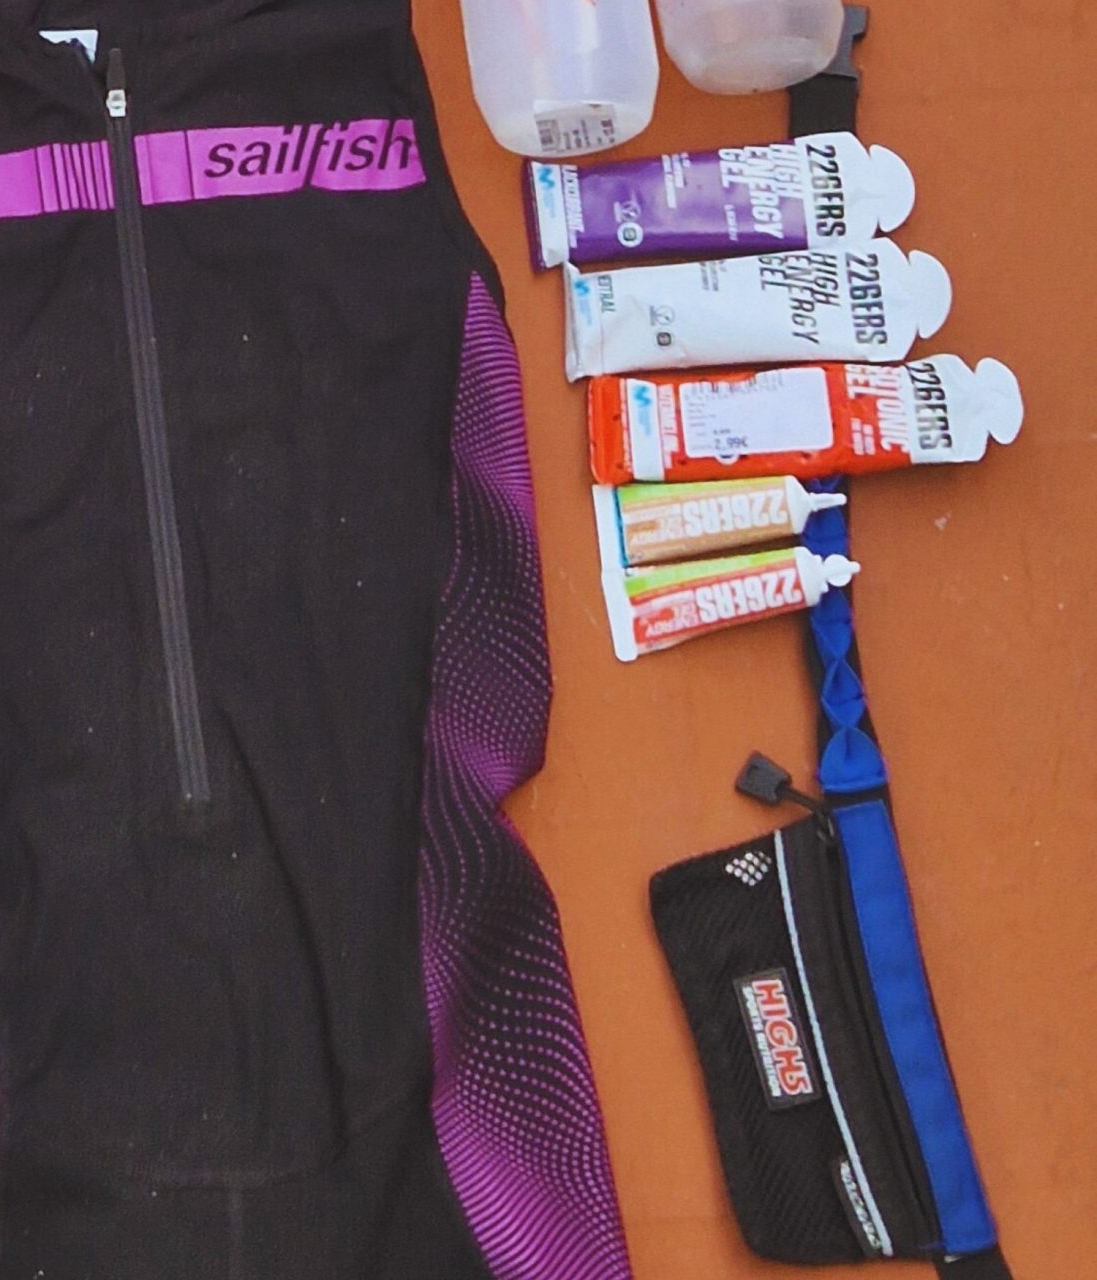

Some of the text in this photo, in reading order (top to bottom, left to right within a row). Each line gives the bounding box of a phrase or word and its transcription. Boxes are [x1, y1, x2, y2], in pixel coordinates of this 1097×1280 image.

[204, 118, 414, 186] sailfish
[718, 148, 748, 188] GEL
[769, 144, 804, 199] HIGH
[743, 146, 784, 239] ENERGY
[805, 143, 847, 238] 226ERS
[758, 255, 789, 291] GEL
[783, 255, 820, 345] ENERGY
[810, 252, 840, 306] HIGH
[845, 252, 888, 345] 226ERS
[905, 362, 953, 450] 226ERS
[682, 488, 789, 538] 226ERS
[694, 567, 803, 624] 226ERS
[751, 979, 814, 1096] HIGH5
